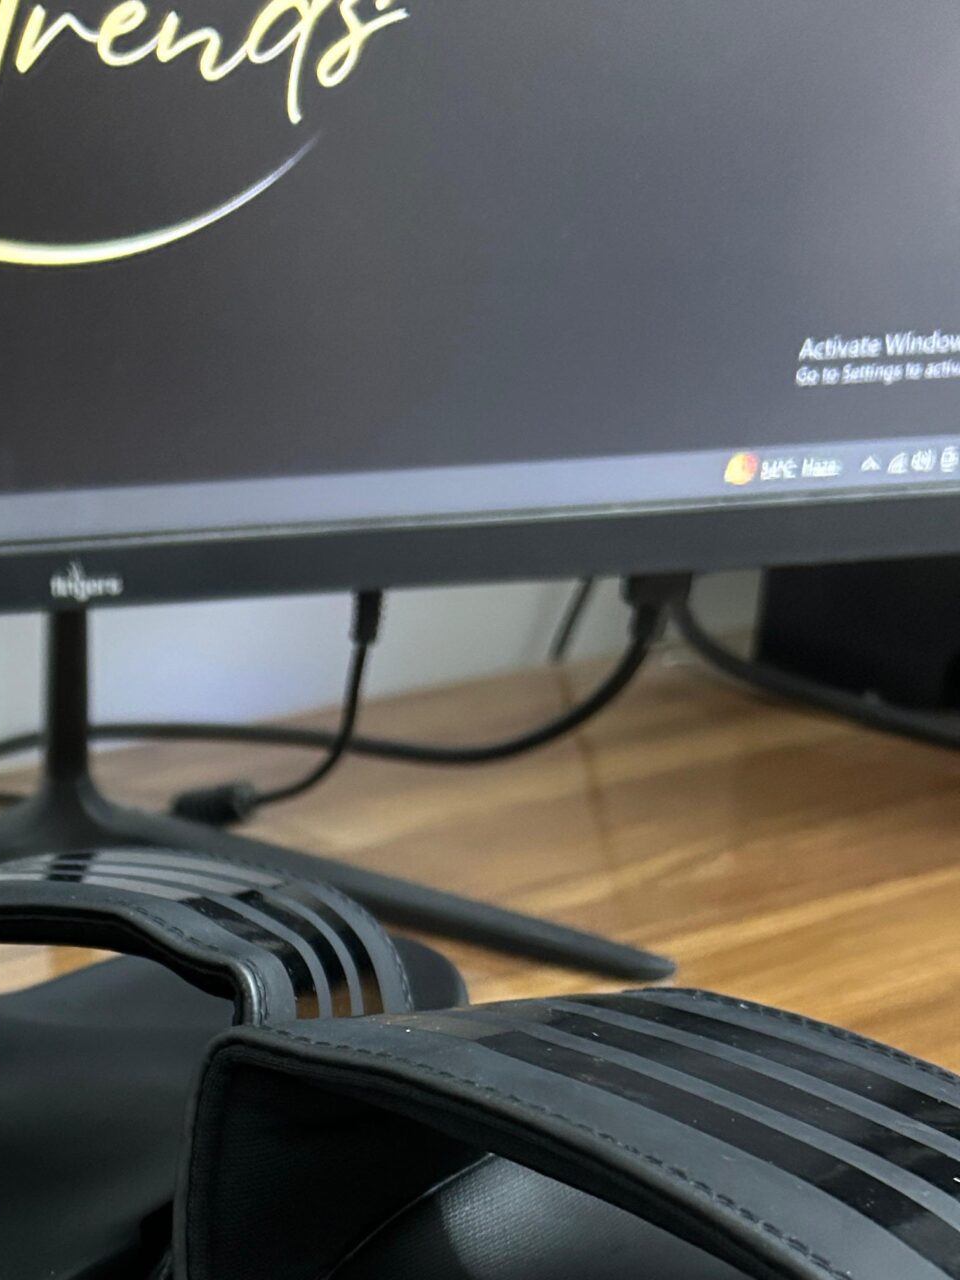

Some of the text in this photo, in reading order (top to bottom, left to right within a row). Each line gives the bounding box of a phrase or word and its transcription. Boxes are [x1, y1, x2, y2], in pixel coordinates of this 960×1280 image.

[798, 335, 882, 361] Activate
[795, 366, 819, 387] Go
[822, 367, 839, 385] to
[841, 362, 903, 385] Settings
[905, 361, 923, 380] to
